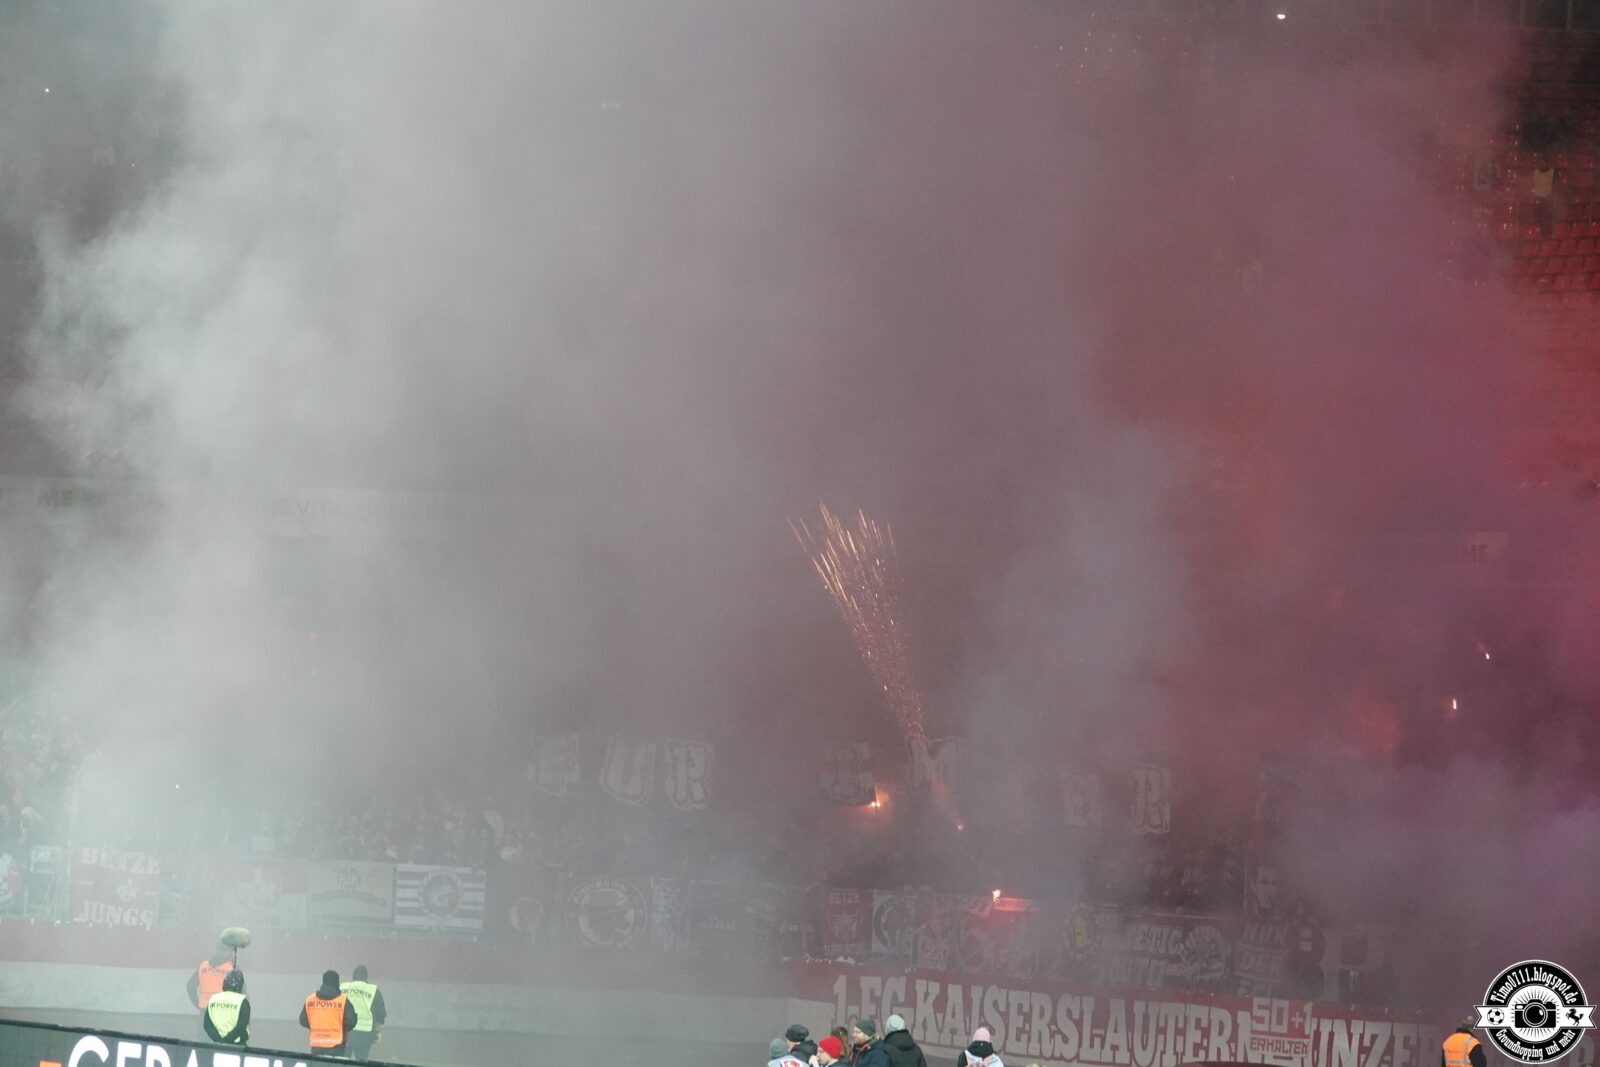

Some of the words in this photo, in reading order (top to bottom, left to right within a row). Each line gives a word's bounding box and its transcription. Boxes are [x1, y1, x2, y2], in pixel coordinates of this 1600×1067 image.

[73, 900, 152, 927] JUNGS
[1252, 997, 1314, 1034] 50+1
[1251, 1037, 1308, 1055] ERHALTEN
